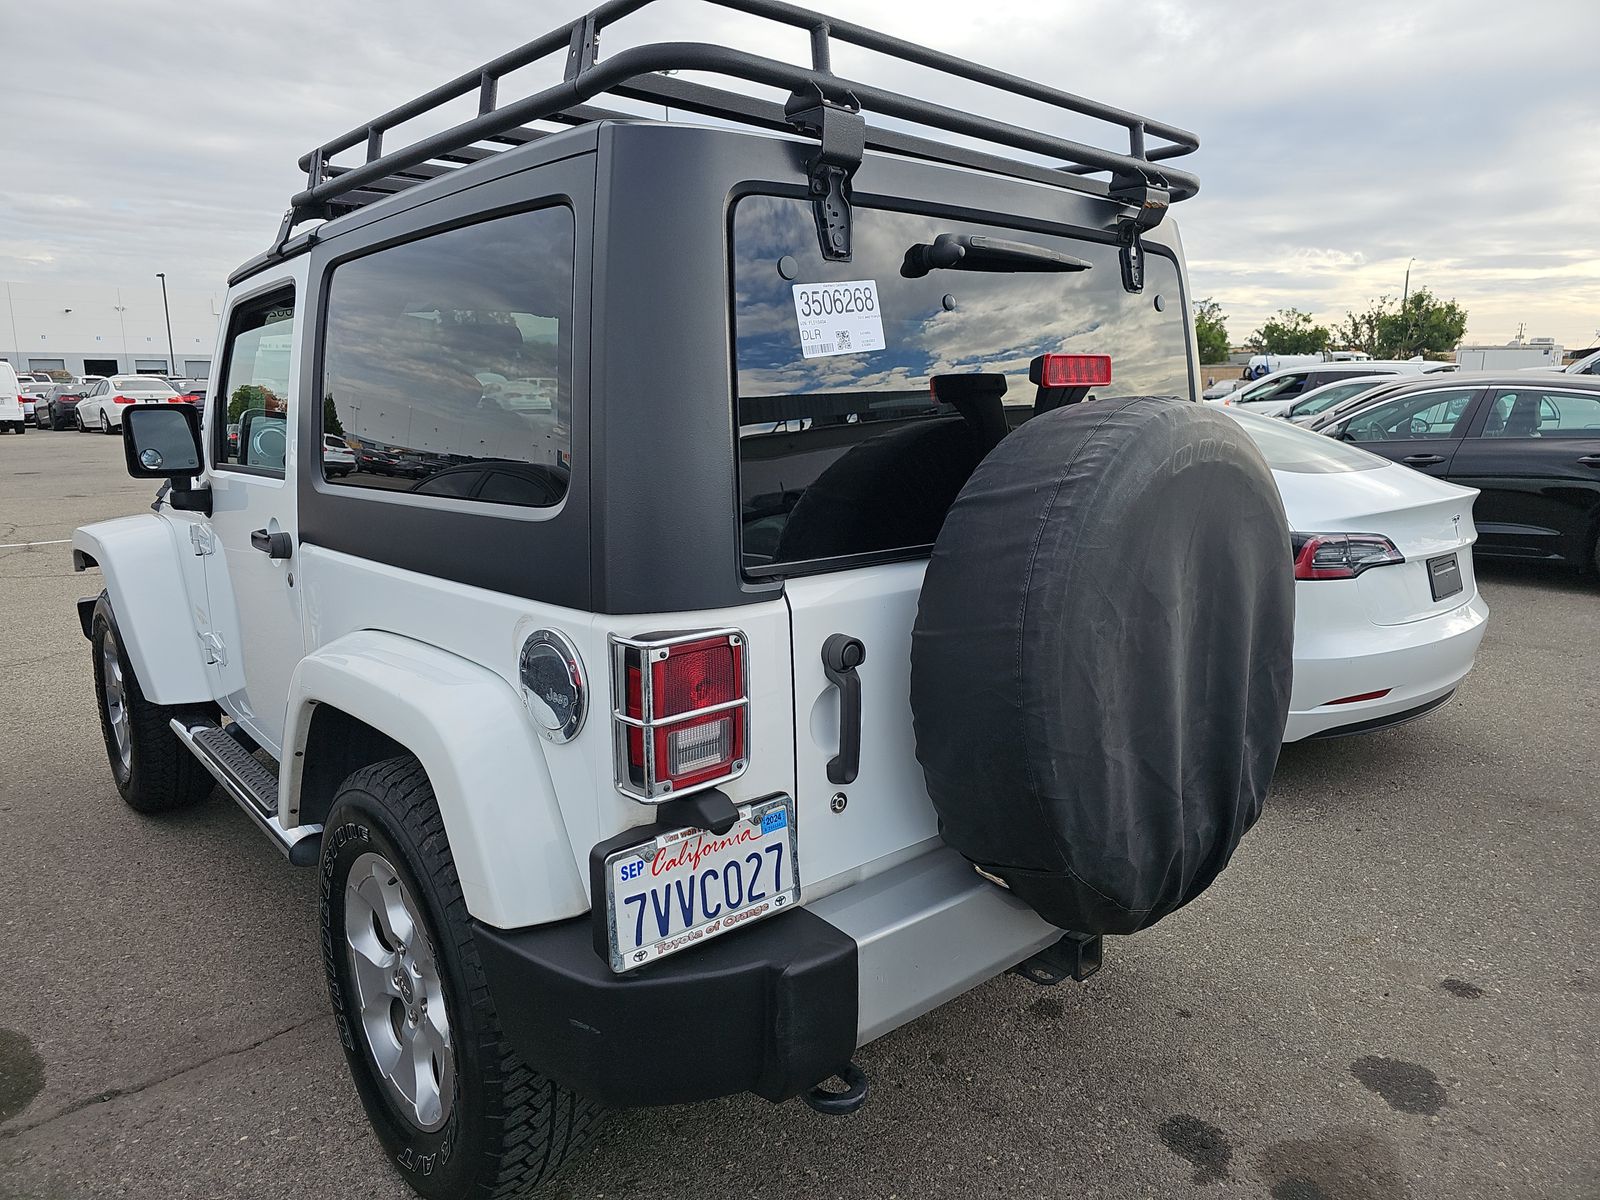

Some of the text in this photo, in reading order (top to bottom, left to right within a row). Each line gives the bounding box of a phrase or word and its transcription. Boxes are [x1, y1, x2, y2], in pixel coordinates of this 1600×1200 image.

[799, 287, 875, 317] 3506268
[801, 329, 822, 341] DLR
[546, 688, 569, 709] Jeep
[766, 813, 782, 825] 2024
[651, 825, 763, 877] California
[621, 861, 645, 881] SEP
[624, 842, 783, 947] 7VVC027
[654, 903, 770, 954] Toyota of Orange
